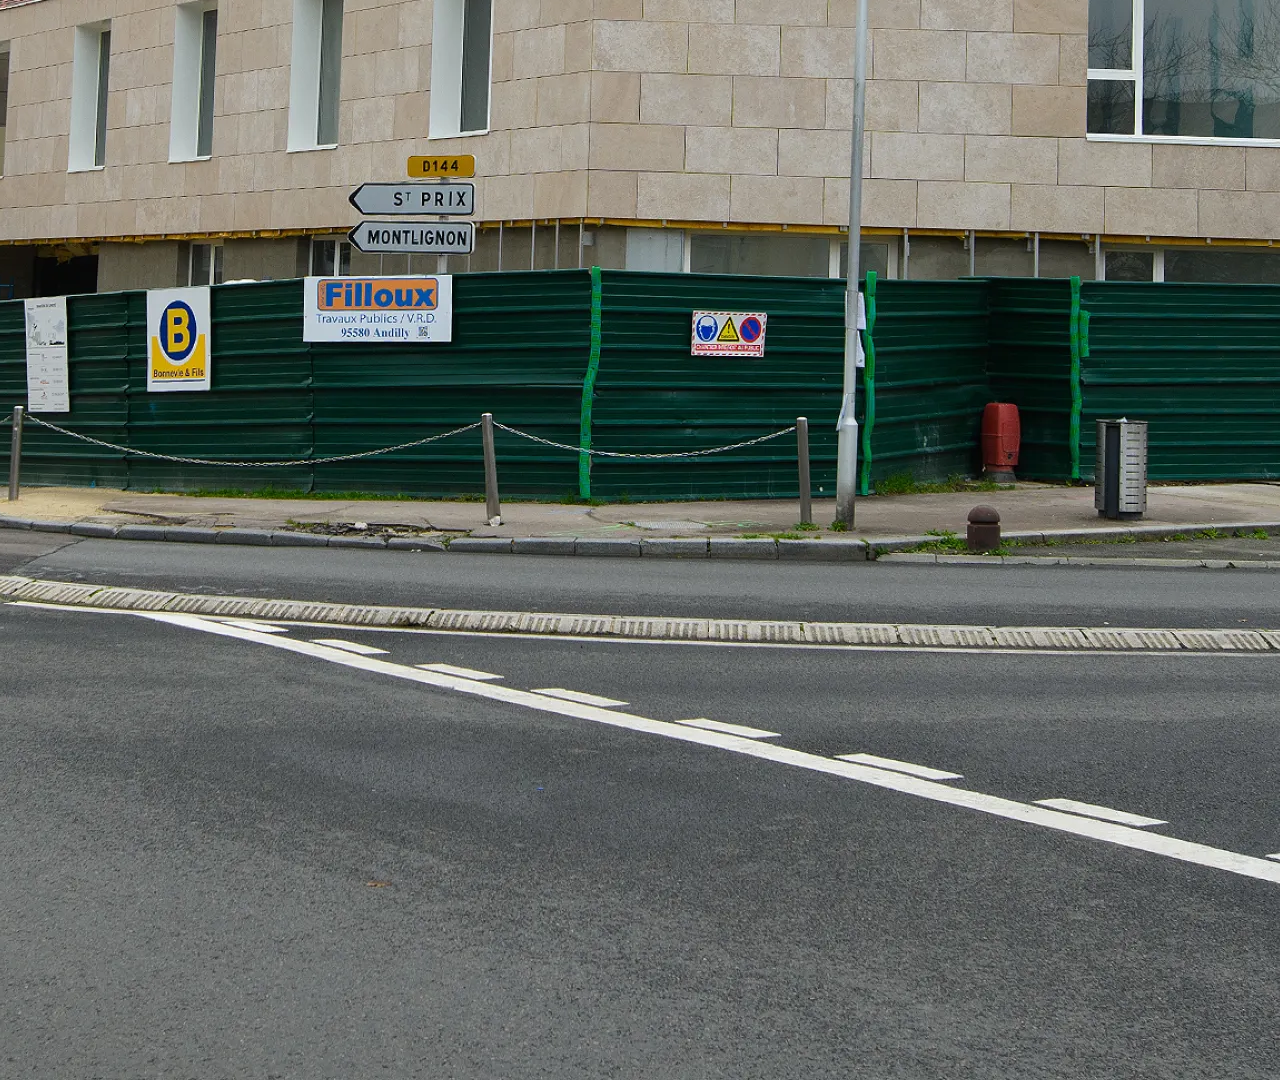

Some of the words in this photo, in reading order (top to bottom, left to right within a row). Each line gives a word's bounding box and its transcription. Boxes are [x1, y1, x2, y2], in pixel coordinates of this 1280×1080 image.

[422, 160, 459, 172] D144
[421, 191, 467, 207] PRIX
[367, 229, 468, 247] MONTLIGNON
[325, 282, 435, 308] Filloux
[316, 313, 357, 324] Travaux
[360, 313, 398, 324] Publics
[407, 313, 437, 324] V.R.D.
[167, 308, 190, 353] B
[341, 327, 370, 338] 95580
[373, 327, 410, 340] Andilly
[153, 368, 184, 378] Bonnevie
[185, 368, 190, 377] &
[192, 368, 205, 377] Fils
